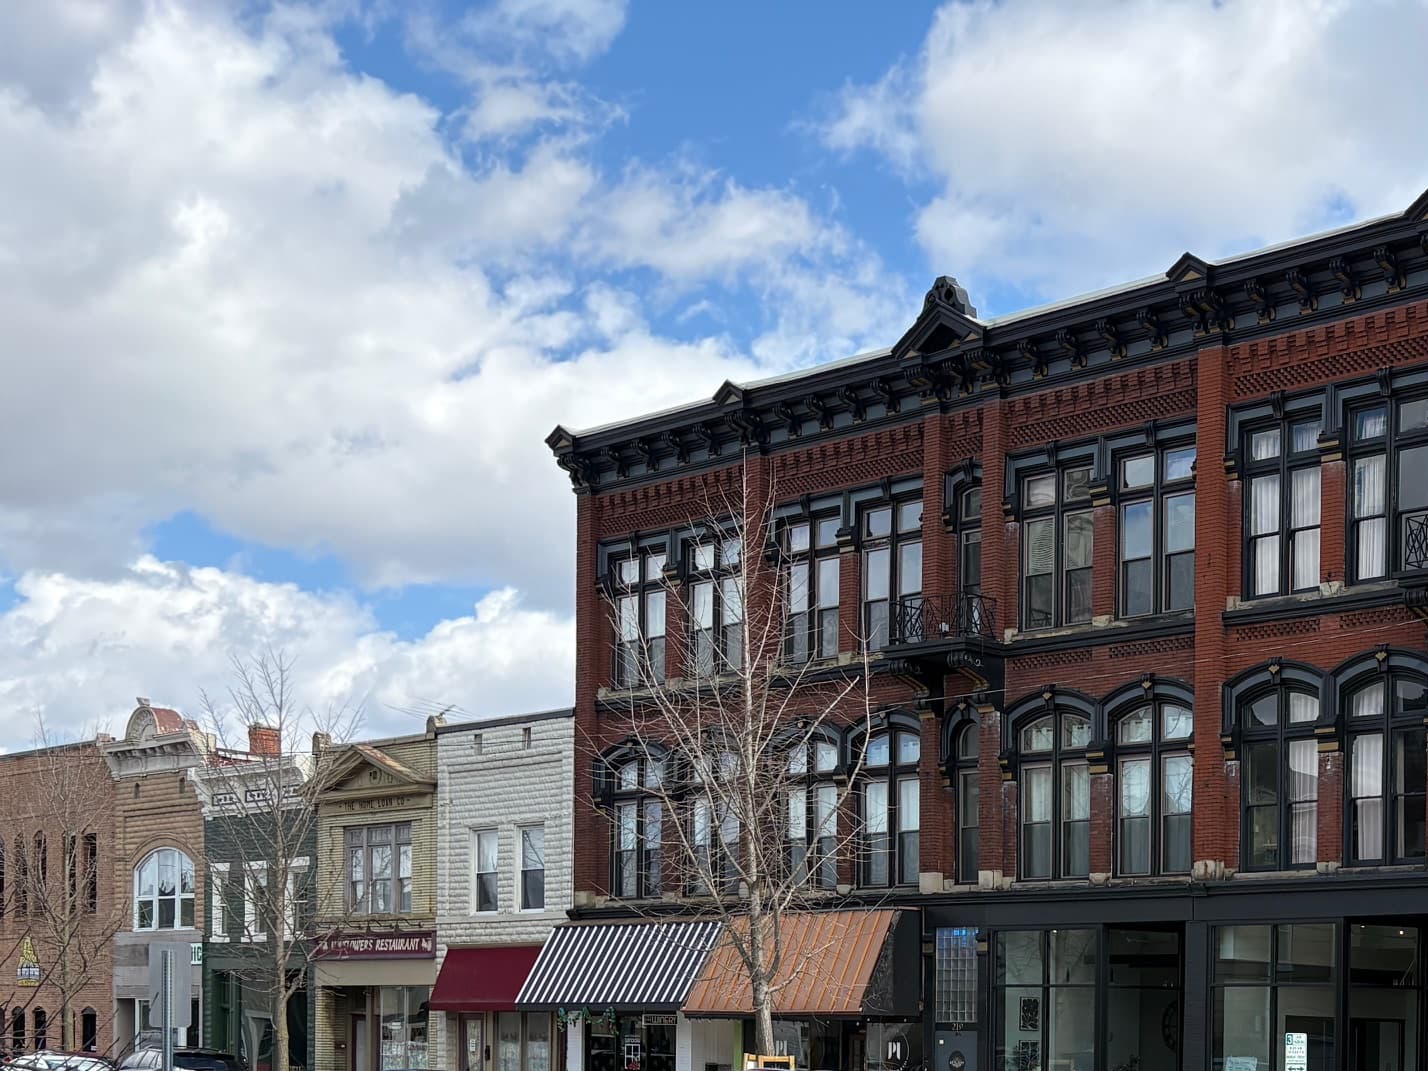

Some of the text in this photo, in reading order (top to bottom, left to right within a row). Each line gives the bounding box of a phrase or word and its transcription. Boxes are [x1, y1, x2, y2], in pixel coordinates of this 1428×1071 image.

[344, 797, 405, 811] THE HOME LOAN CO
[375, 938, 419, 951] RESTAURANT
